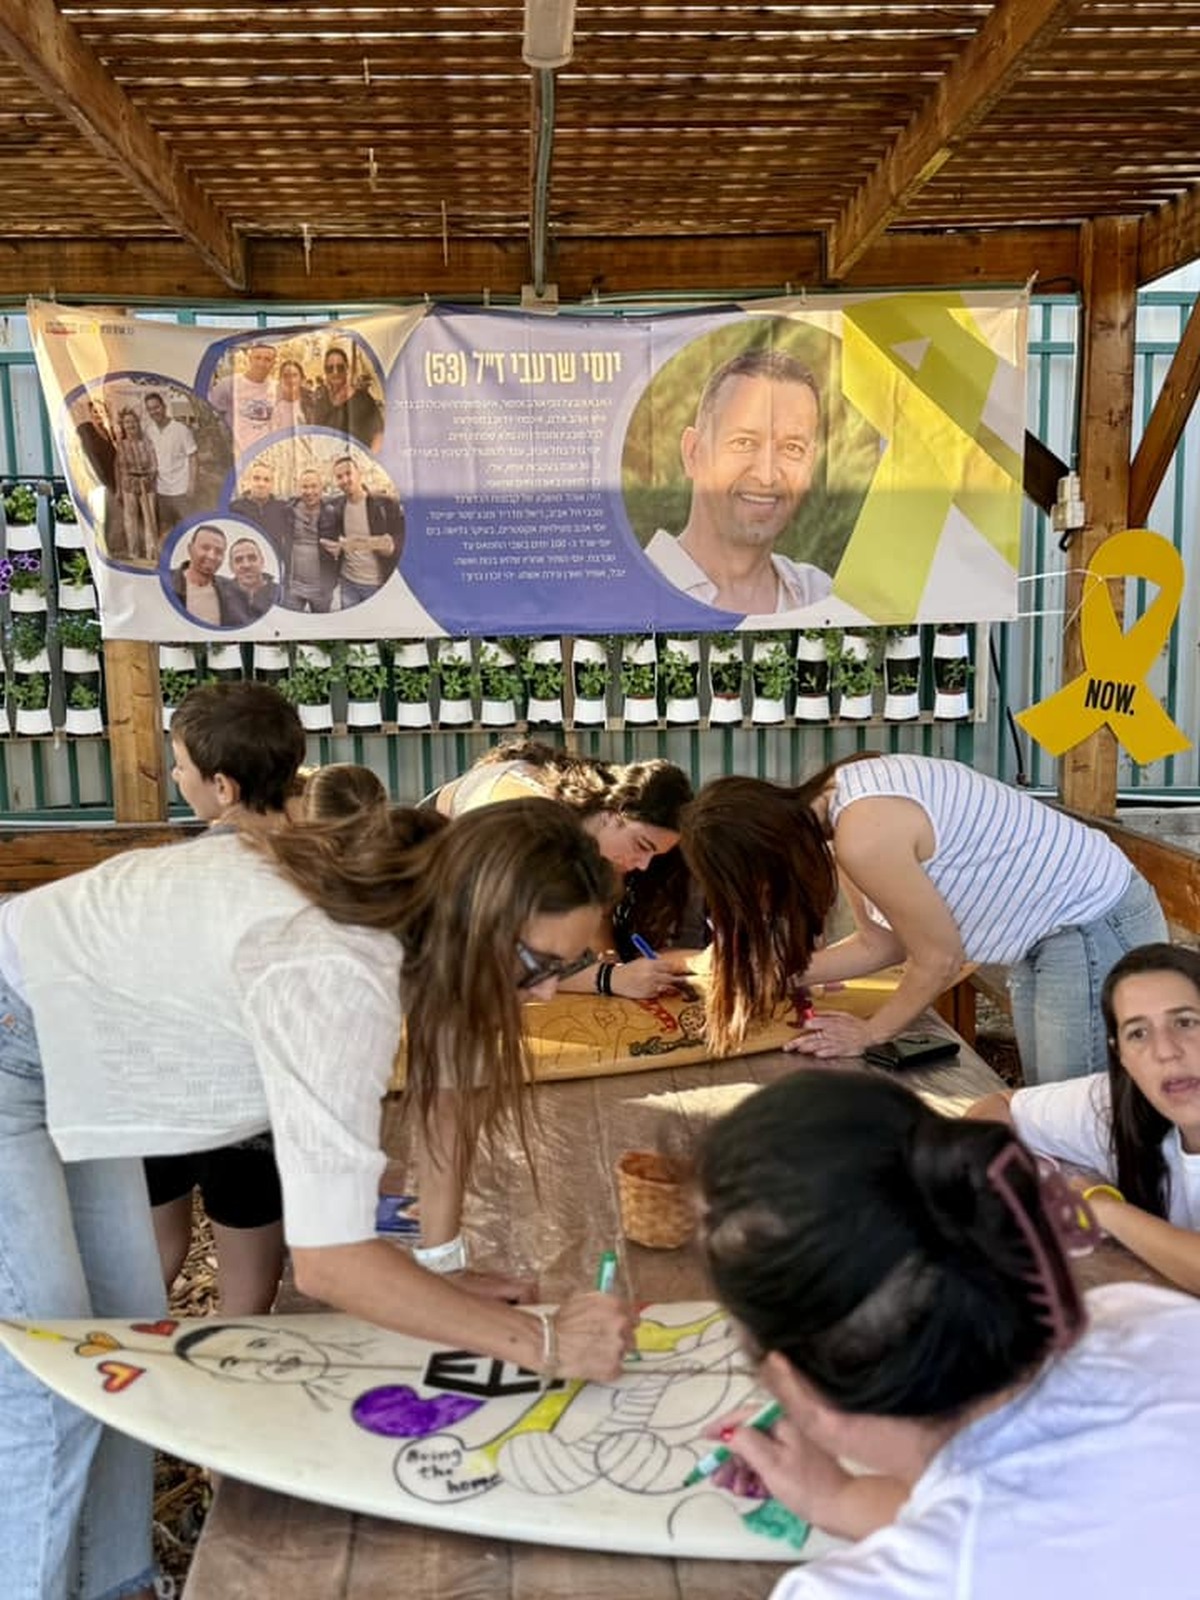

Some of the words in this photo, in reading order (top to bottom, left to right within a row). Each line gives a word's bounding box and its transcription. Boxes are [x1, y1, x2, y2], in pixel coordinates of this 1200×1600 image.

[425, 350, 467, 387] (53)
[510, 351, 576, 384] שרעבי
[582, 351, 621, 383] יוסי
[1085, 678, 1136, 716] NOW.
